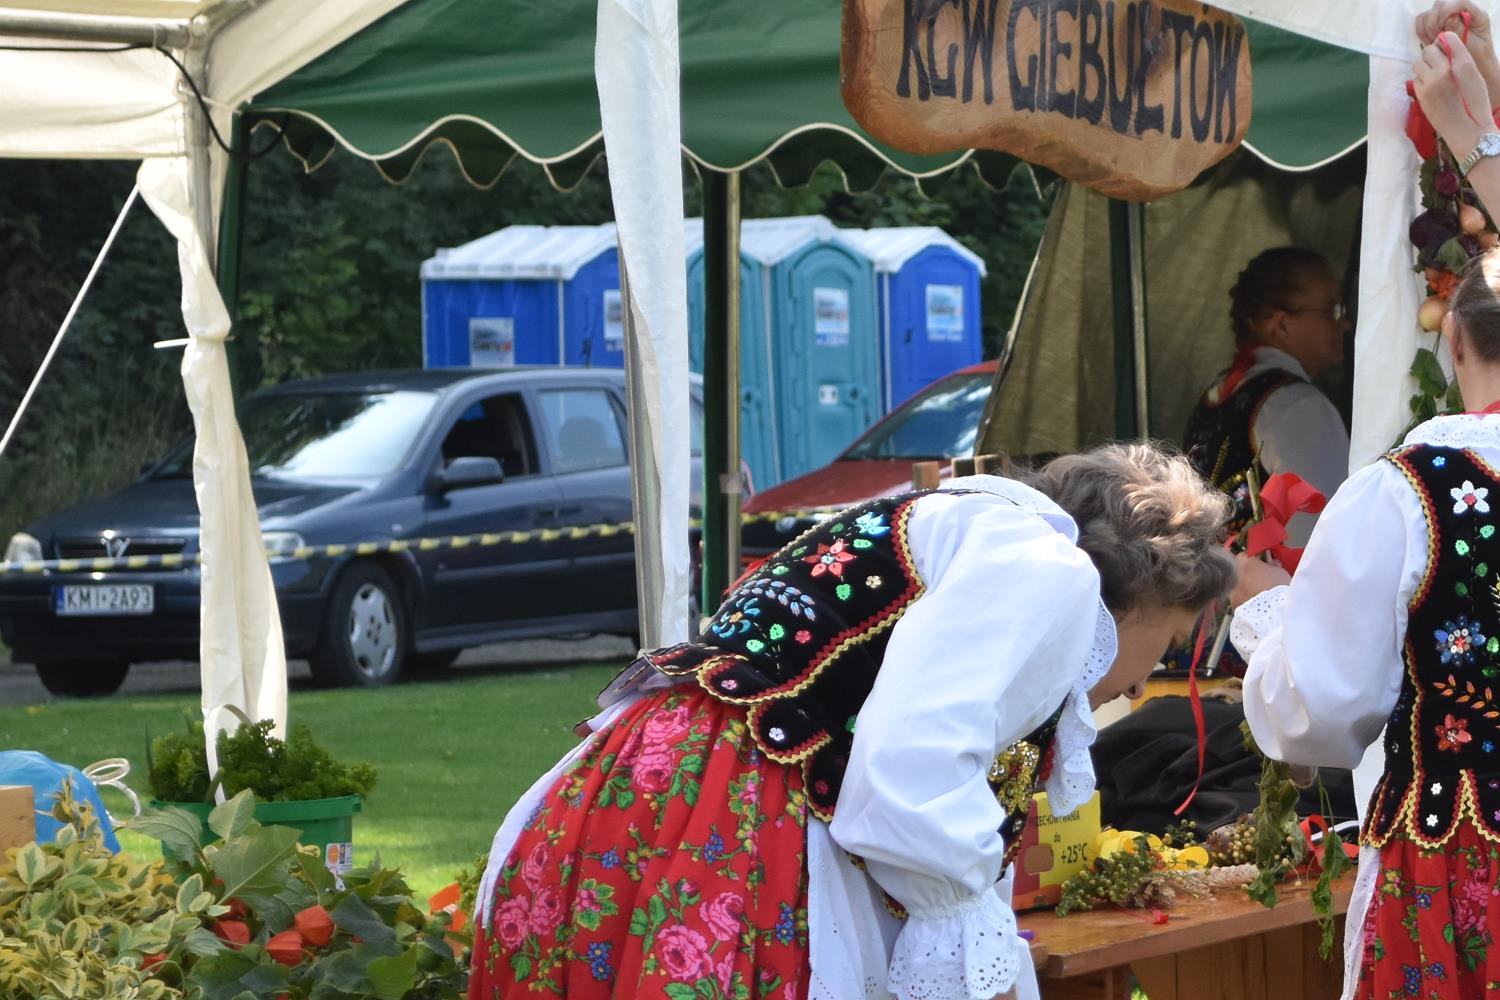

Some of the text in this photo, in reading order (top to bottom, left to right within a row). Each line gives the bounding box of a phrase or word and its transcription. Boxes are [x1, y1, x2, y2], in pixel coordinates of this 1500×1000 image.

[896, 0, 998, 105] KGW
[110, 586, 151, 609] 2A93
[1053, 832, 1062, 843] do
[1061, 843, 1088, 864] +25°C
